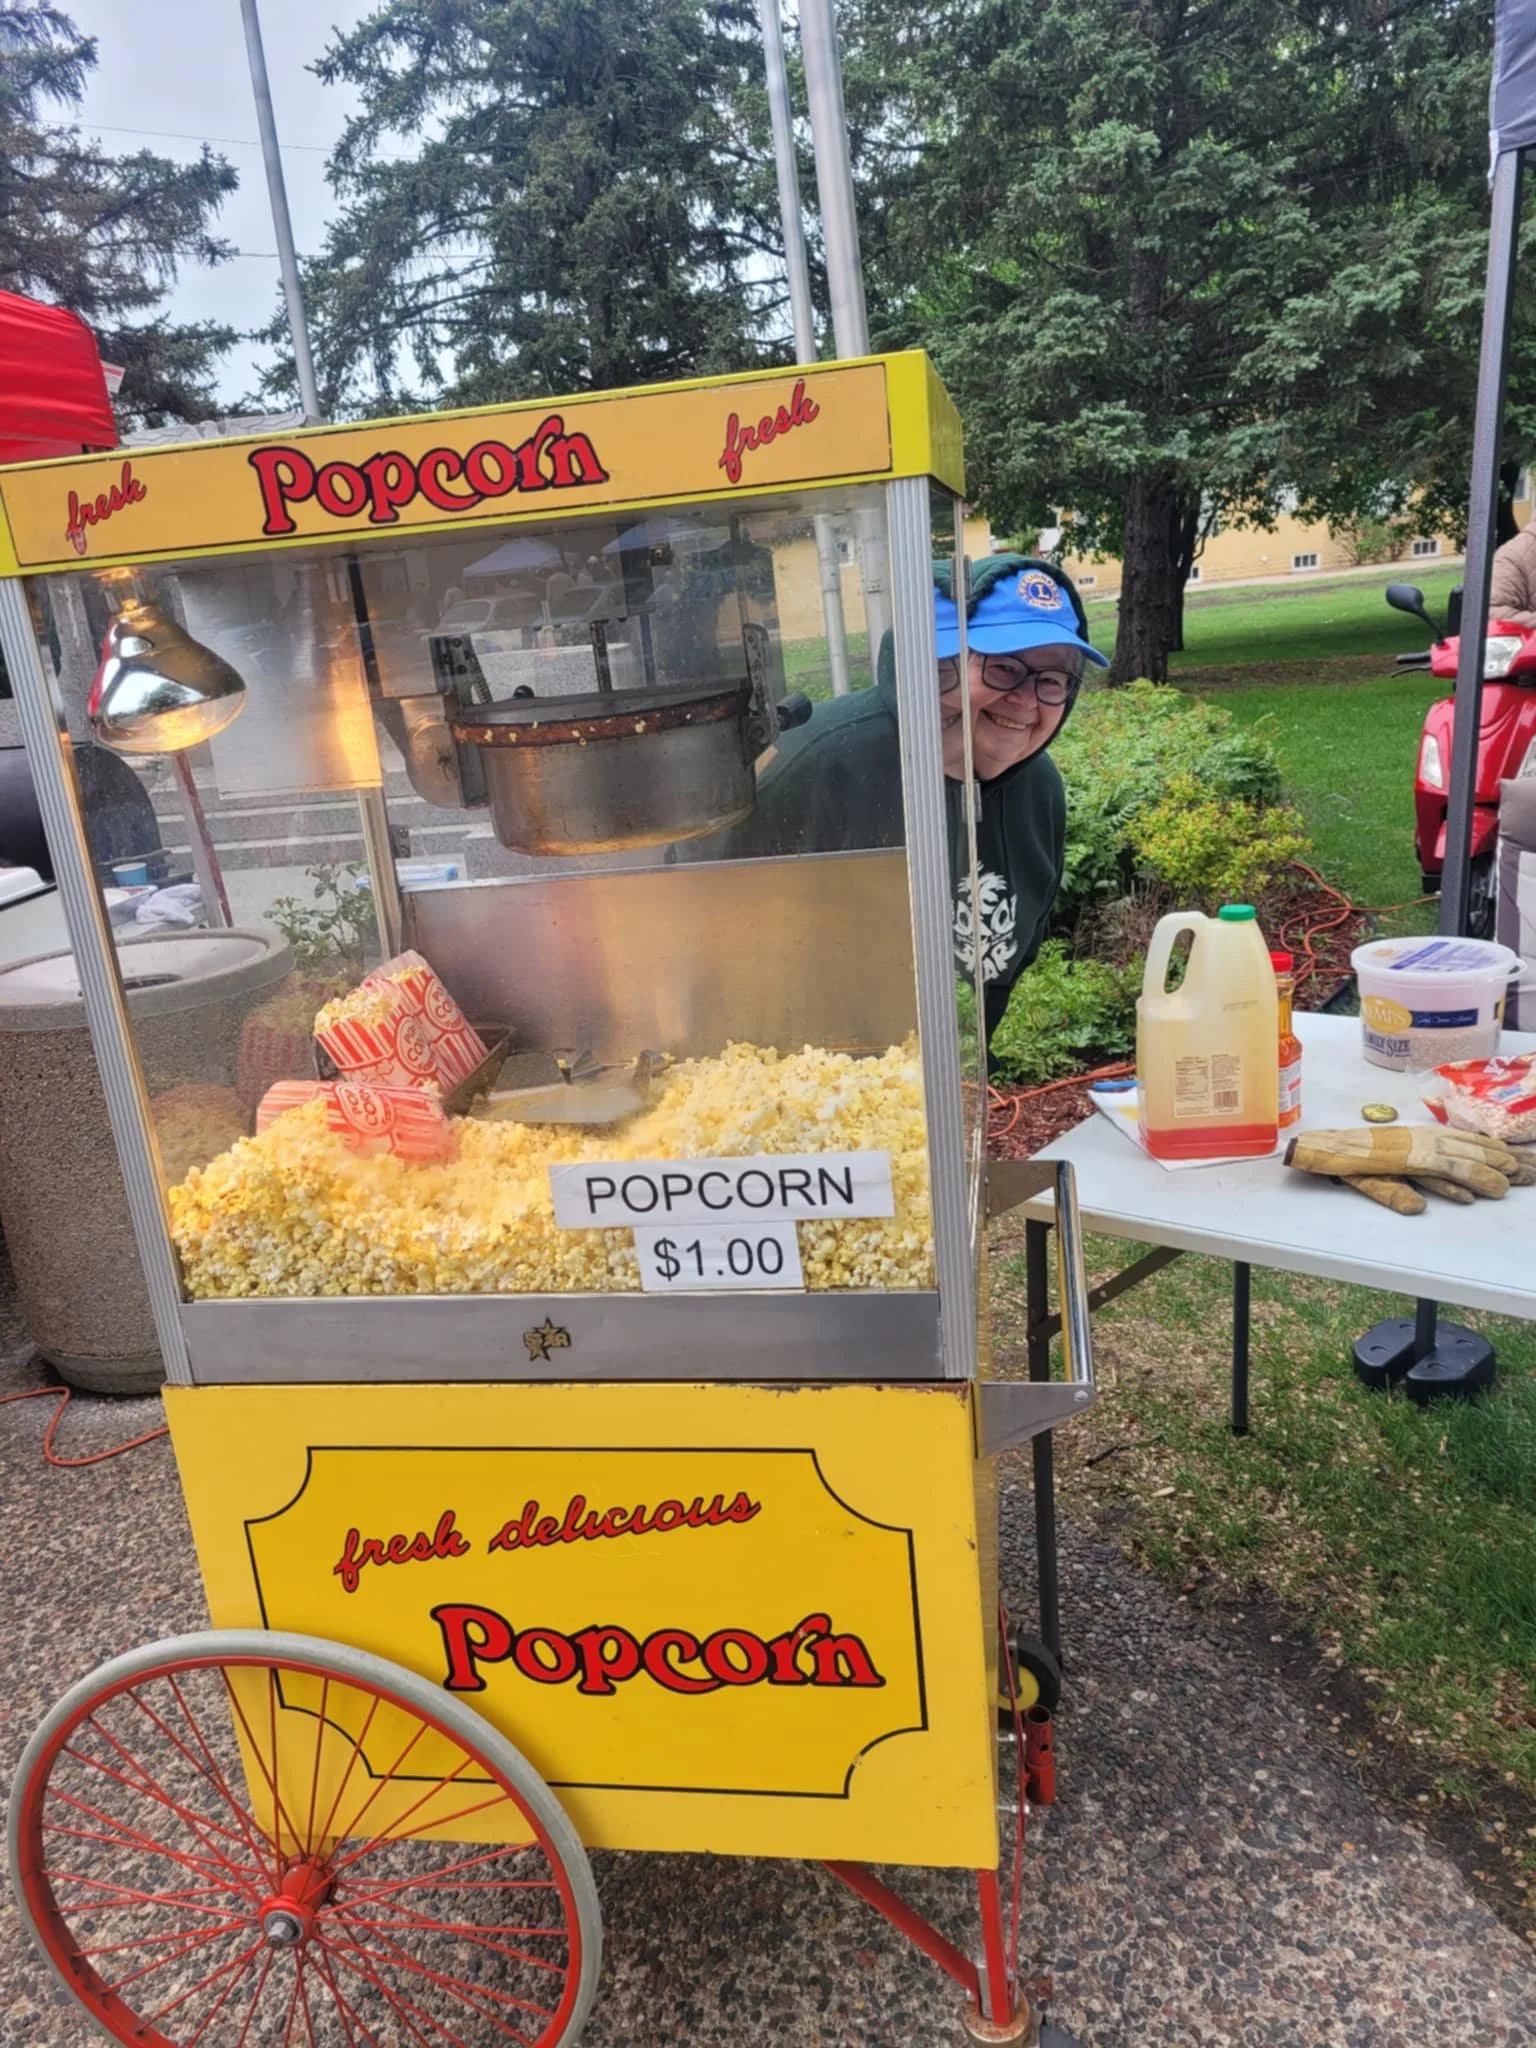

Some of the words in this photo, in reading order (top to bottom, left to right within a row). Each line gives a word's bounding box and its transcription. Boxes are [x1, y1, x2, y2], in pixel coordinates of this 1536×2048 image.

[65, 460, 147, 555] fresh
[248, 414, 609, 535] Popcorn
[718, 378, 820, 484] fresh
[586, 1166, 854, 1214] POPCORN
[653, 1237, 784, 1281] $1.00
[333, 1510, 470, 1593] fresh
[488, 1492, 762, 1554] delicious
[430, 1603, 886, 1696] Popcorn
